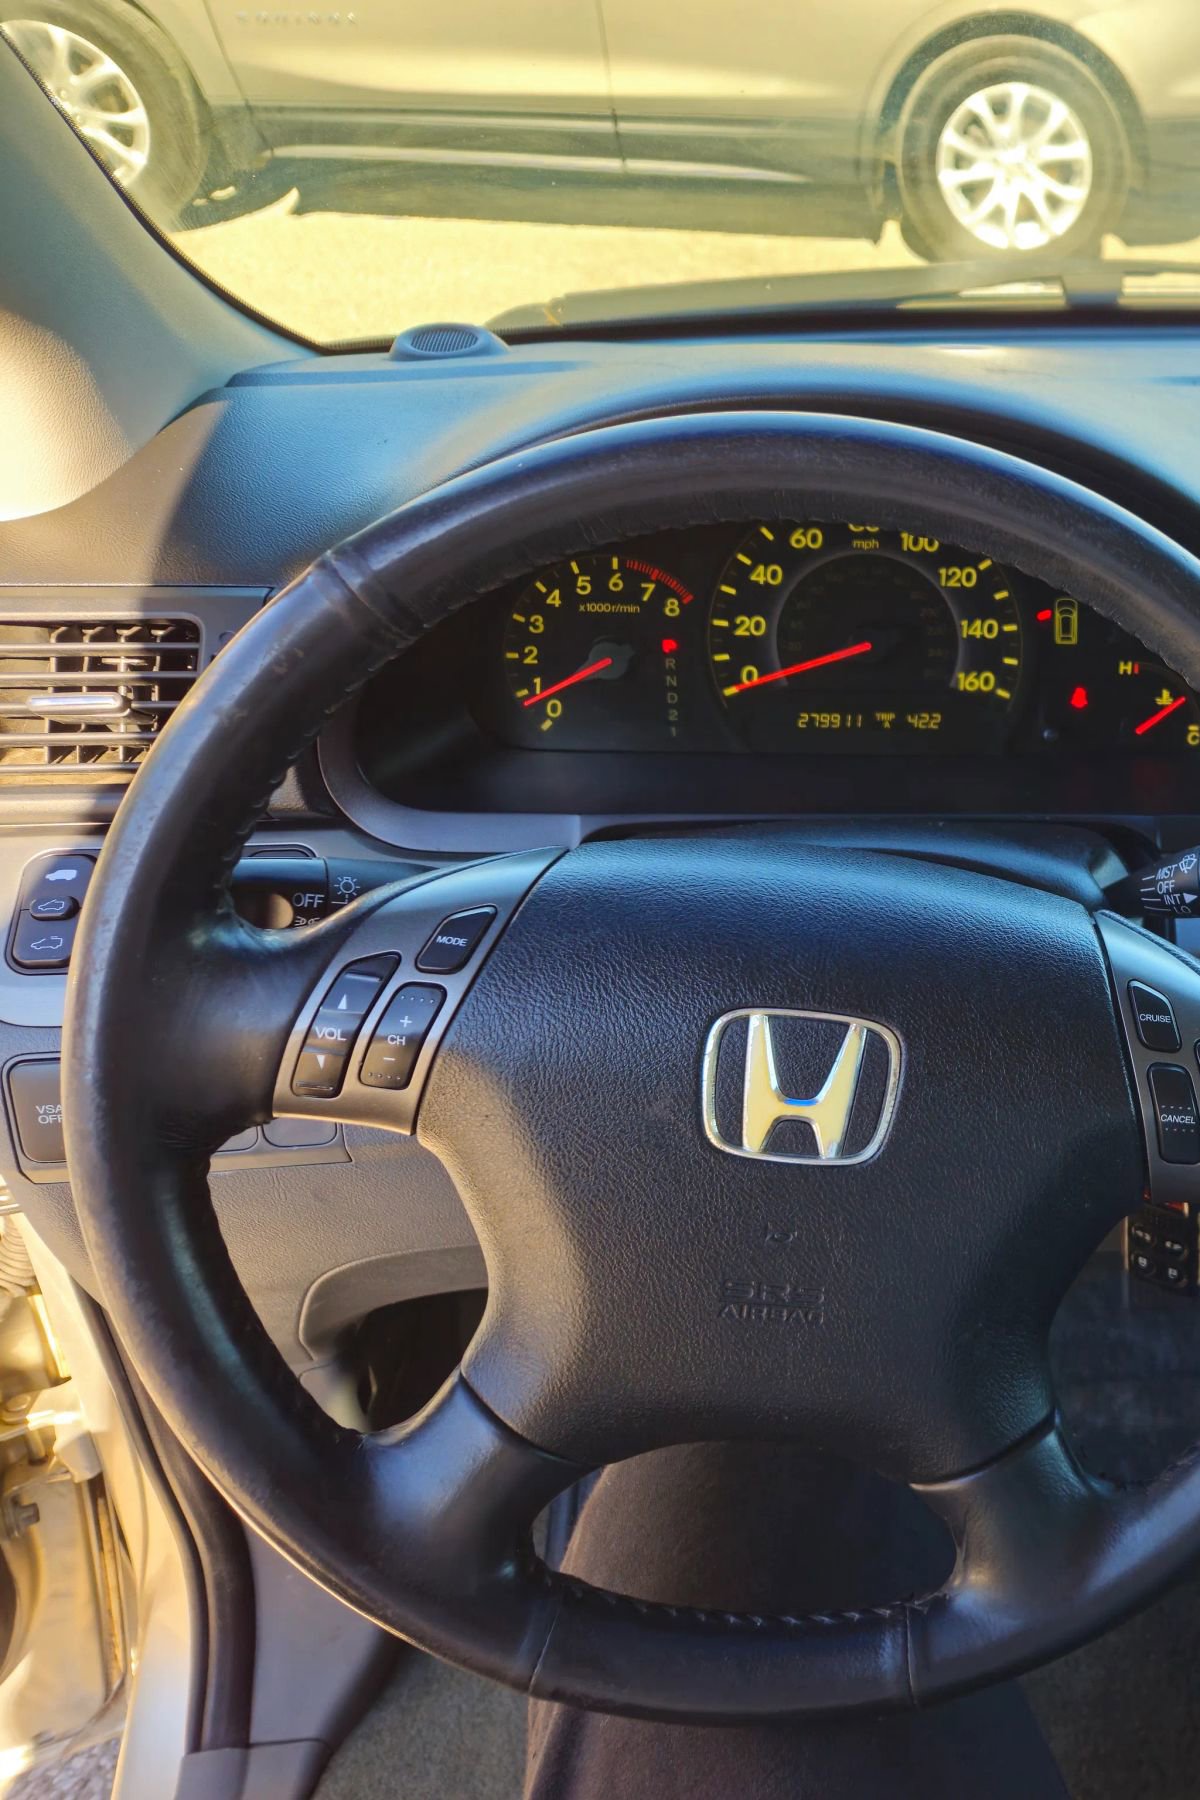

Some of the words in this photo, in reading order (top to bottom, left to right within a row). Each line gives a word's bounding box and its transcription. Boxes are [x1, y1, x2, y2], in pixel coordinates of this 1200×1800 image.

[789, 528, 823, 549] 60
[853, 539, 879, 550] mph
[900, 532, 939, 552] 100
[608, 573, 624, 592] 6
[750, 564, 783, 585] 40
[939, 567, 977, 587] 120
[575, 575, 592, 595] 5
[641, 583, 656, 602] 7
[546, 589, 562, 608] 4
[664, 598, 680, 617] 8
[528, 615, 544, 634] 3
[733, 616, 766, 636] 20
[960, 619, 999, 639] 140
[523, 646, 538, 665] 2
[1118, 661, 1132, 675] H
[533, 677, 542, 695] 1
[957, 672, 996, 692] 160
[546, 700, 562, 718] 0
[797, 713, 862, 728] 279911
[1187, 732, 1200, 745] C
[1156, 864, 1177, 880] MIST
[1157, 880, 1175, 893] OFF
[293, 893, 325, 908] OFF
[1164, 893, 1181, 905] INT
[436, 935, 467, 947] MODE
[1139, 1013, 1172, 1023] CRUISE
[315, 1026, 347, 1041] VOL
[387, 1034, 406, 1046] CH
[1160, 1113, 1196, 1124] CANCEL
